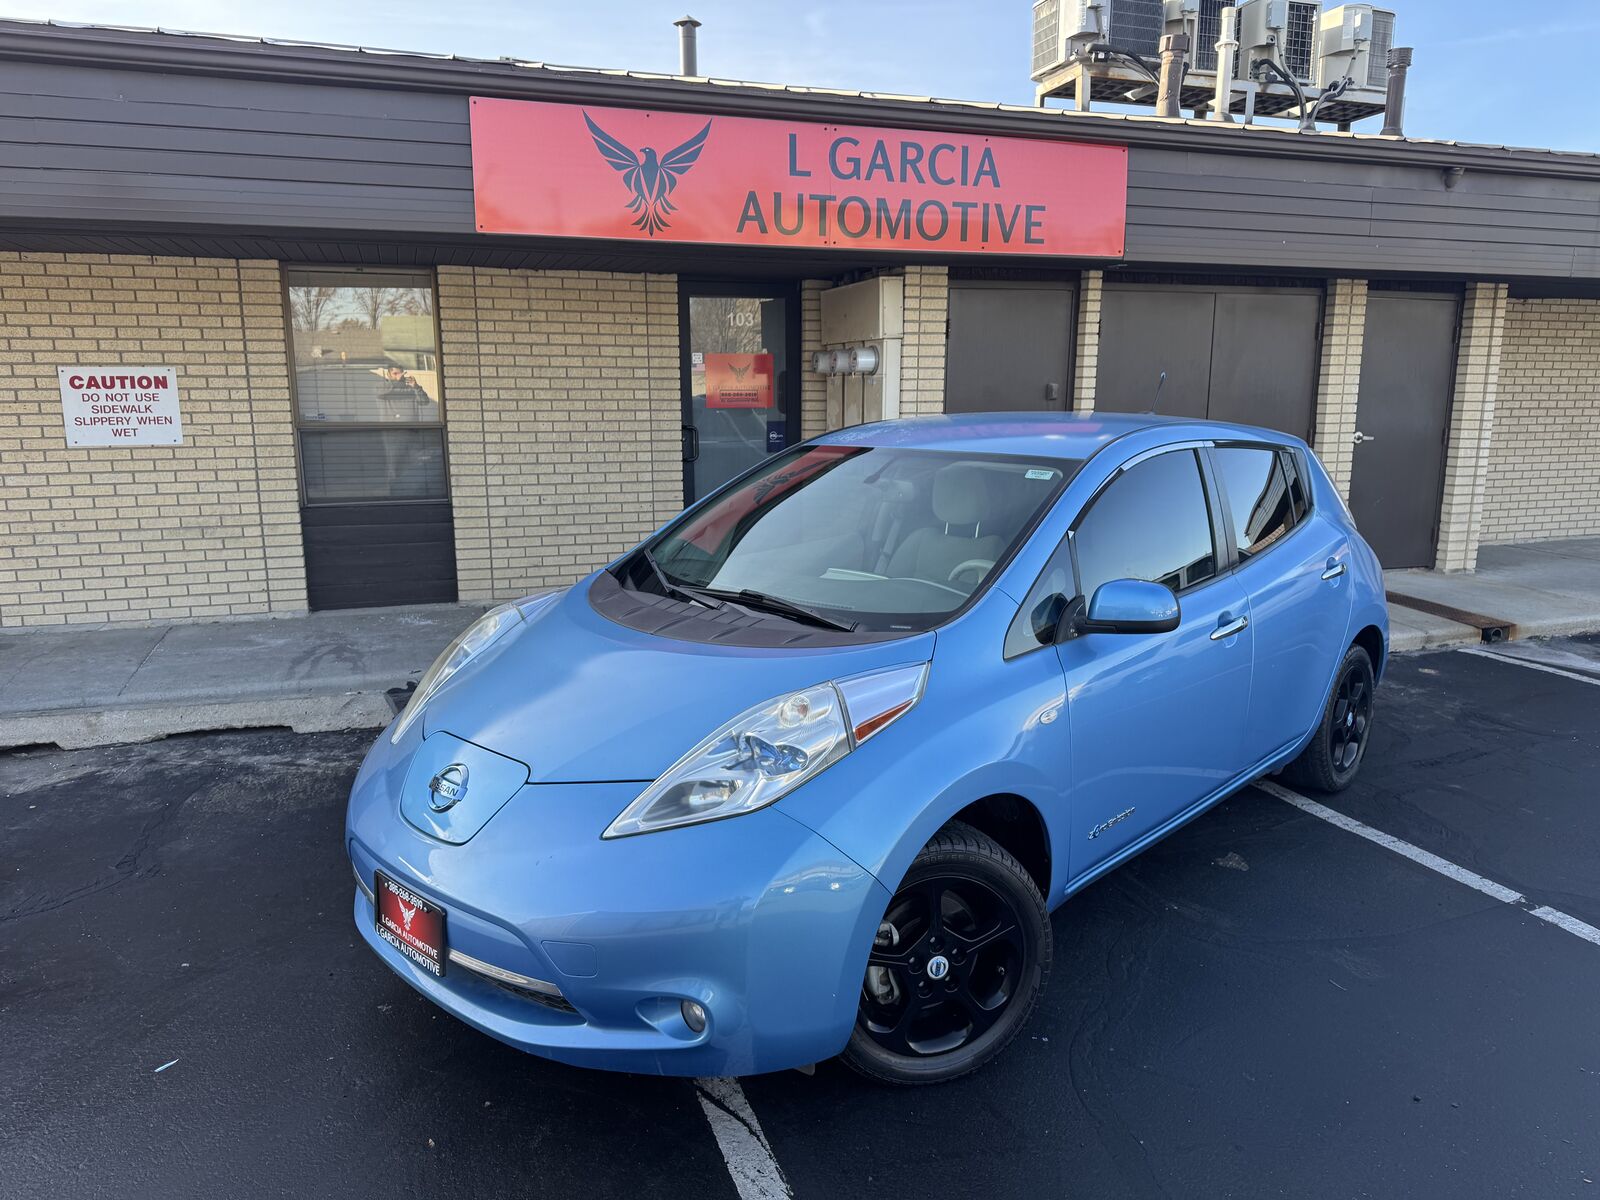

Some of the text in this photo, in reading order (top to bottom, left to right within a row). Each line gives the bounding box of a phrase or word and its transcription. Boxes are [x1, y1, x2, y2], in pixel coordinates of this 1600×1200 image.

[788, 133, 1001, 188] L GARCIA
[736, 190, 1047, 245] AUTOMOTIVE
[727, 312, 754, 327] 103
[69, 375, 168, 390] CAUTION
[81, 392, 160, 403] DO NOT USE
[91, 405, 153, 414] SIDEWALK
[74, 416, 173, 426] SLIPPERY WHEN
[112, 428, 138, 437] WET
[385, 917, 402, 935] GARCIA
[402, 931, 438, 959] AUTOMOTIVE
[380, 928, 400, 950] GARCIA
[400, 944, 440, 977] AUTOMOTIVE
